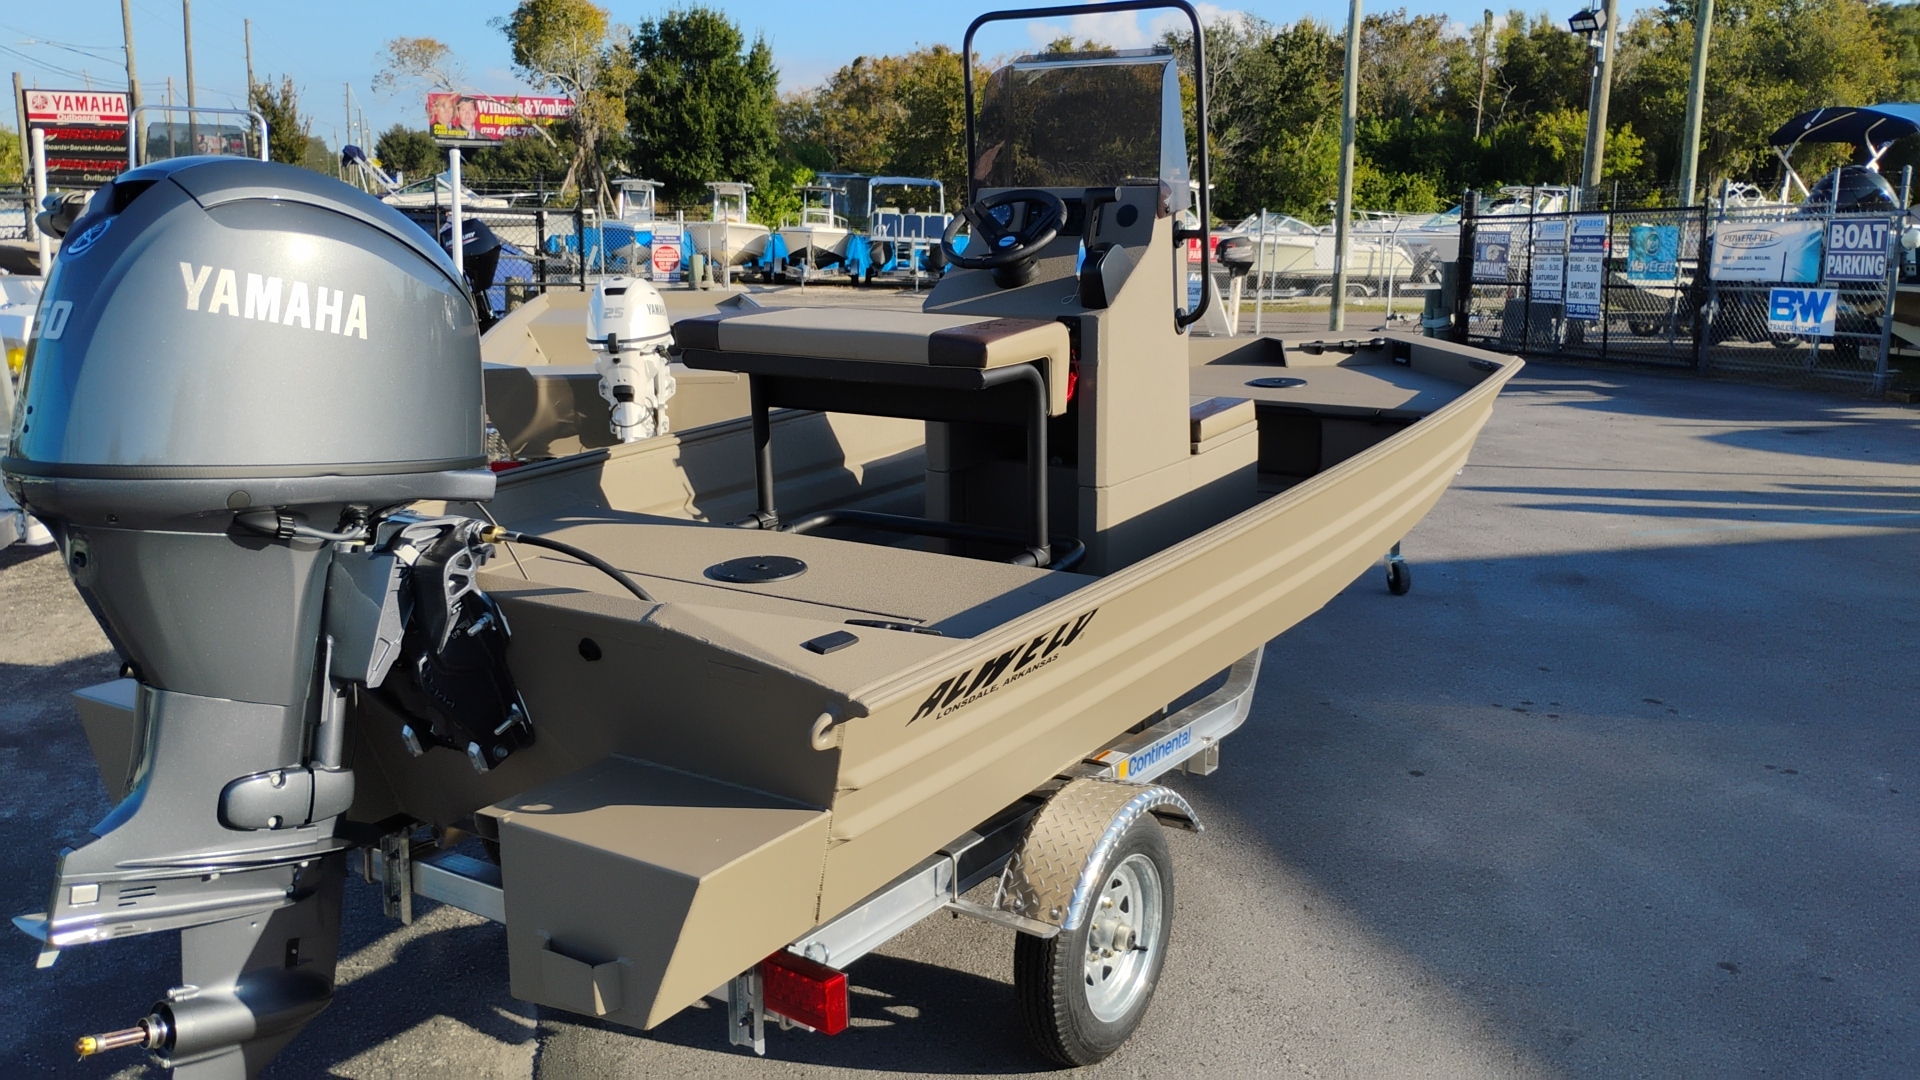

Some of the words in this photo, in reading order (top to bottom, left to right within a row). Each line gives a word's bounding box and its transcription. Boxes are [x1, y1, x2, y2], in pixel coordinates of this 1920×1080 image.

[52, 95, 125, 112] YAMAHA
[477, 100, 523, 114] Winters
[524, 99, 533, 115] &
[57, 113, 100, 121] Outboards
[479, 114, 493, 124] Get
[44, 128, 125, 140] MERCURY
[480, 127, 496, 135] (727)
[497, 126, 540, 137] 446-76
[47, 158, 126, 170] MERCURY
[1476, 233, 1509, 244] CUSTOMER
[1723, 233, 1776, 242] POWER-POLE
[1830, 224, 1888, 249] BOAT
[1473, 261, 1506, 276] ENTRANCE
[1629, 260, 1675, 274] MayCraft
[1826, 255, 1886, 276] PARKING
[1570, 282, 1597, 290] SATURDAY
[179, 262, 369, 340] YAMAHA
[602, 306, 625, 319] 25
[1769, 323, 1793, 332] TRAILER
[1794, 324, 1821, 333] HITCHES
[904, 606, 1101, 728] ALWELD
[935, 683, 999, 721] LONSDALE,
[1002, 652, 1060, 687] ARKANSAS
[1128, 726, 1192, 776] Continental
